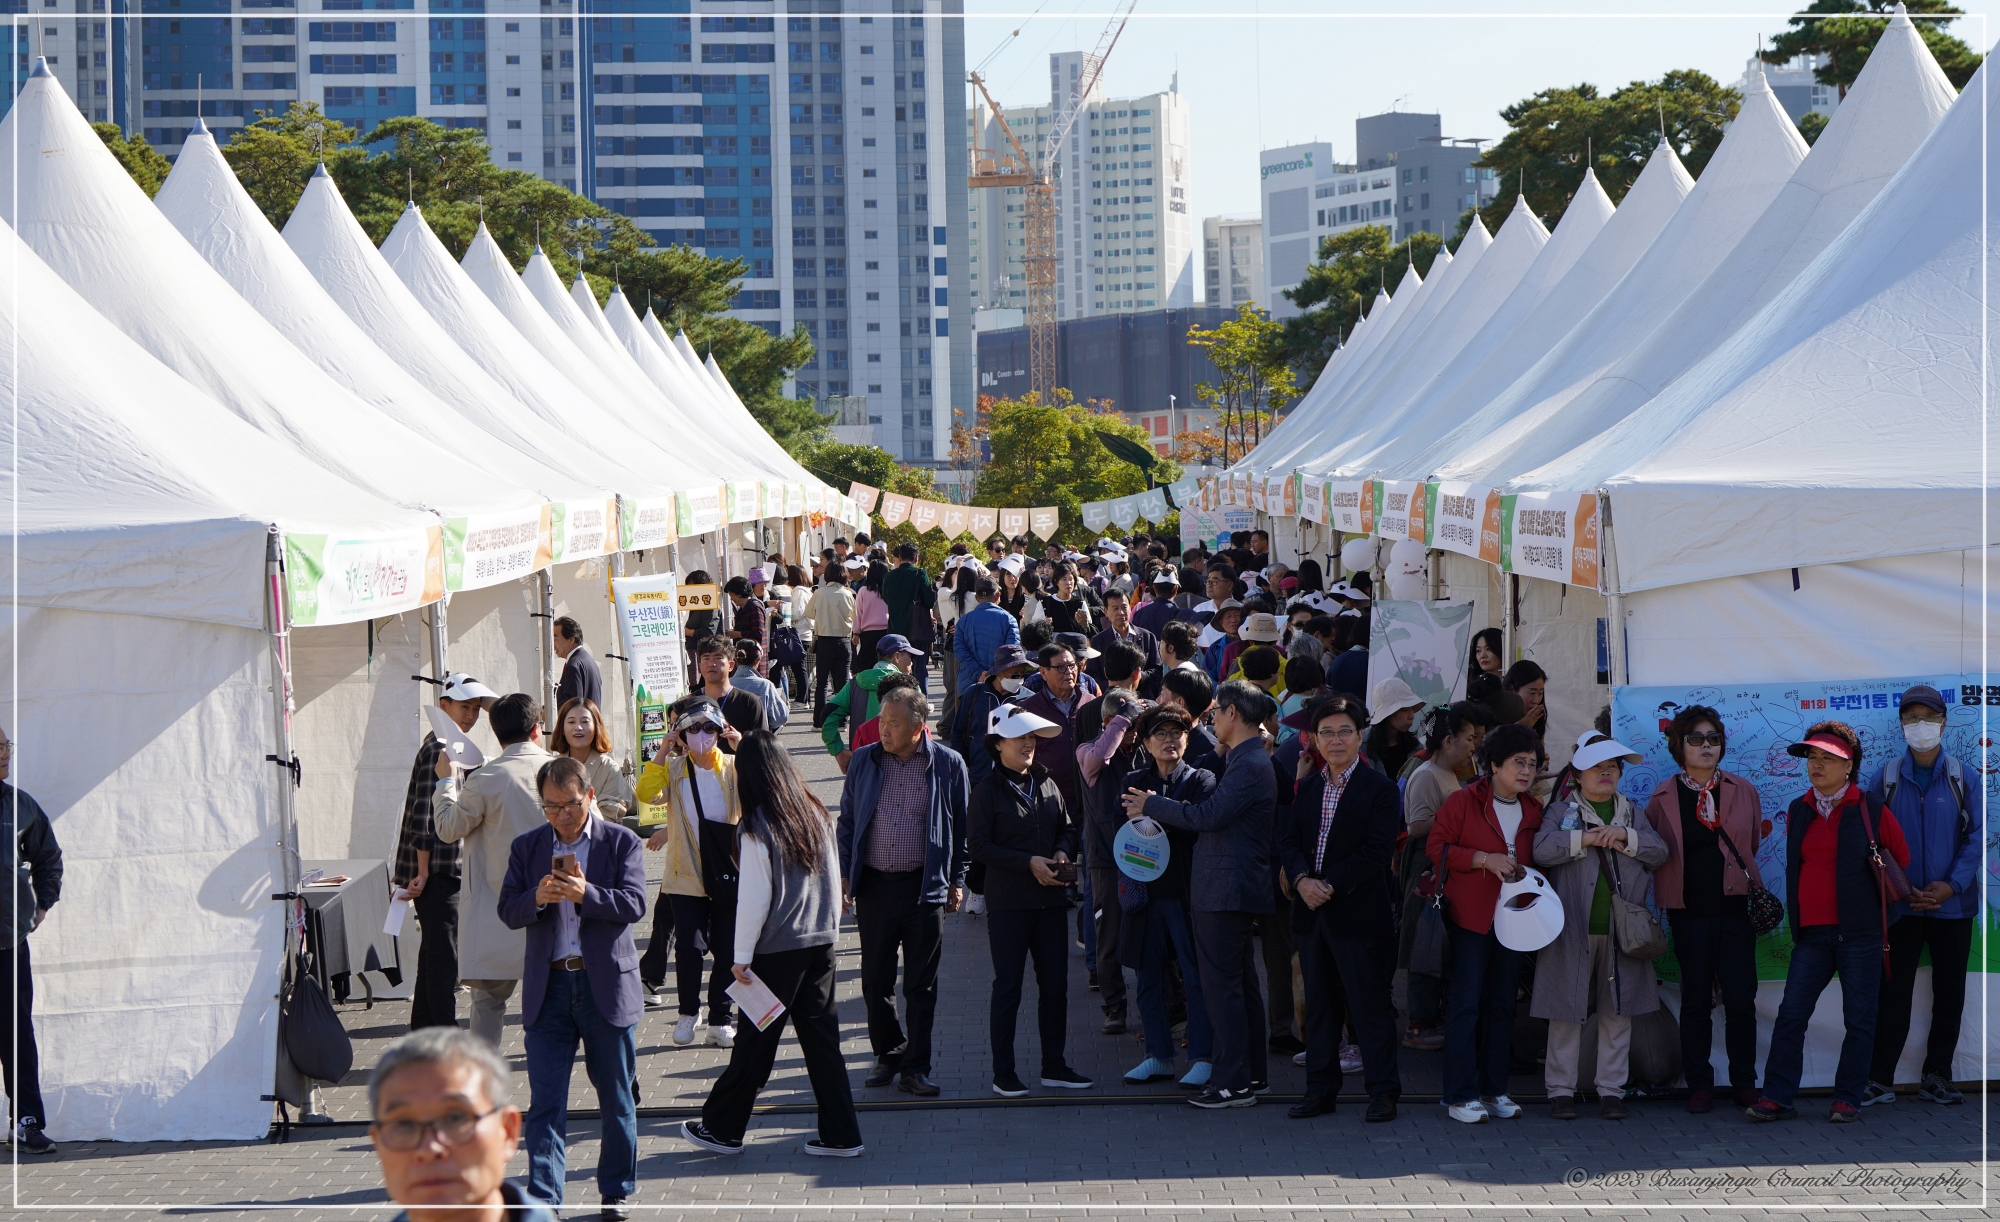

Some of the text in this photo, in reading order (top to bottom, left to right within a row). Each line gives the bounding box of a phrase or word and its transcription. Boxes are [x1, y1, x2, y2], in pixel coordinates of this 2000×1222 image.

[1261, 160, 1304, 180] greencore
[982, 369, 1025, 386] DL Constrction
[632, 622, 676, 638] 그린레인저
[1800, 699, 1826, 710] 제1회
[1830, 693, 1888, 710] 부전1동
